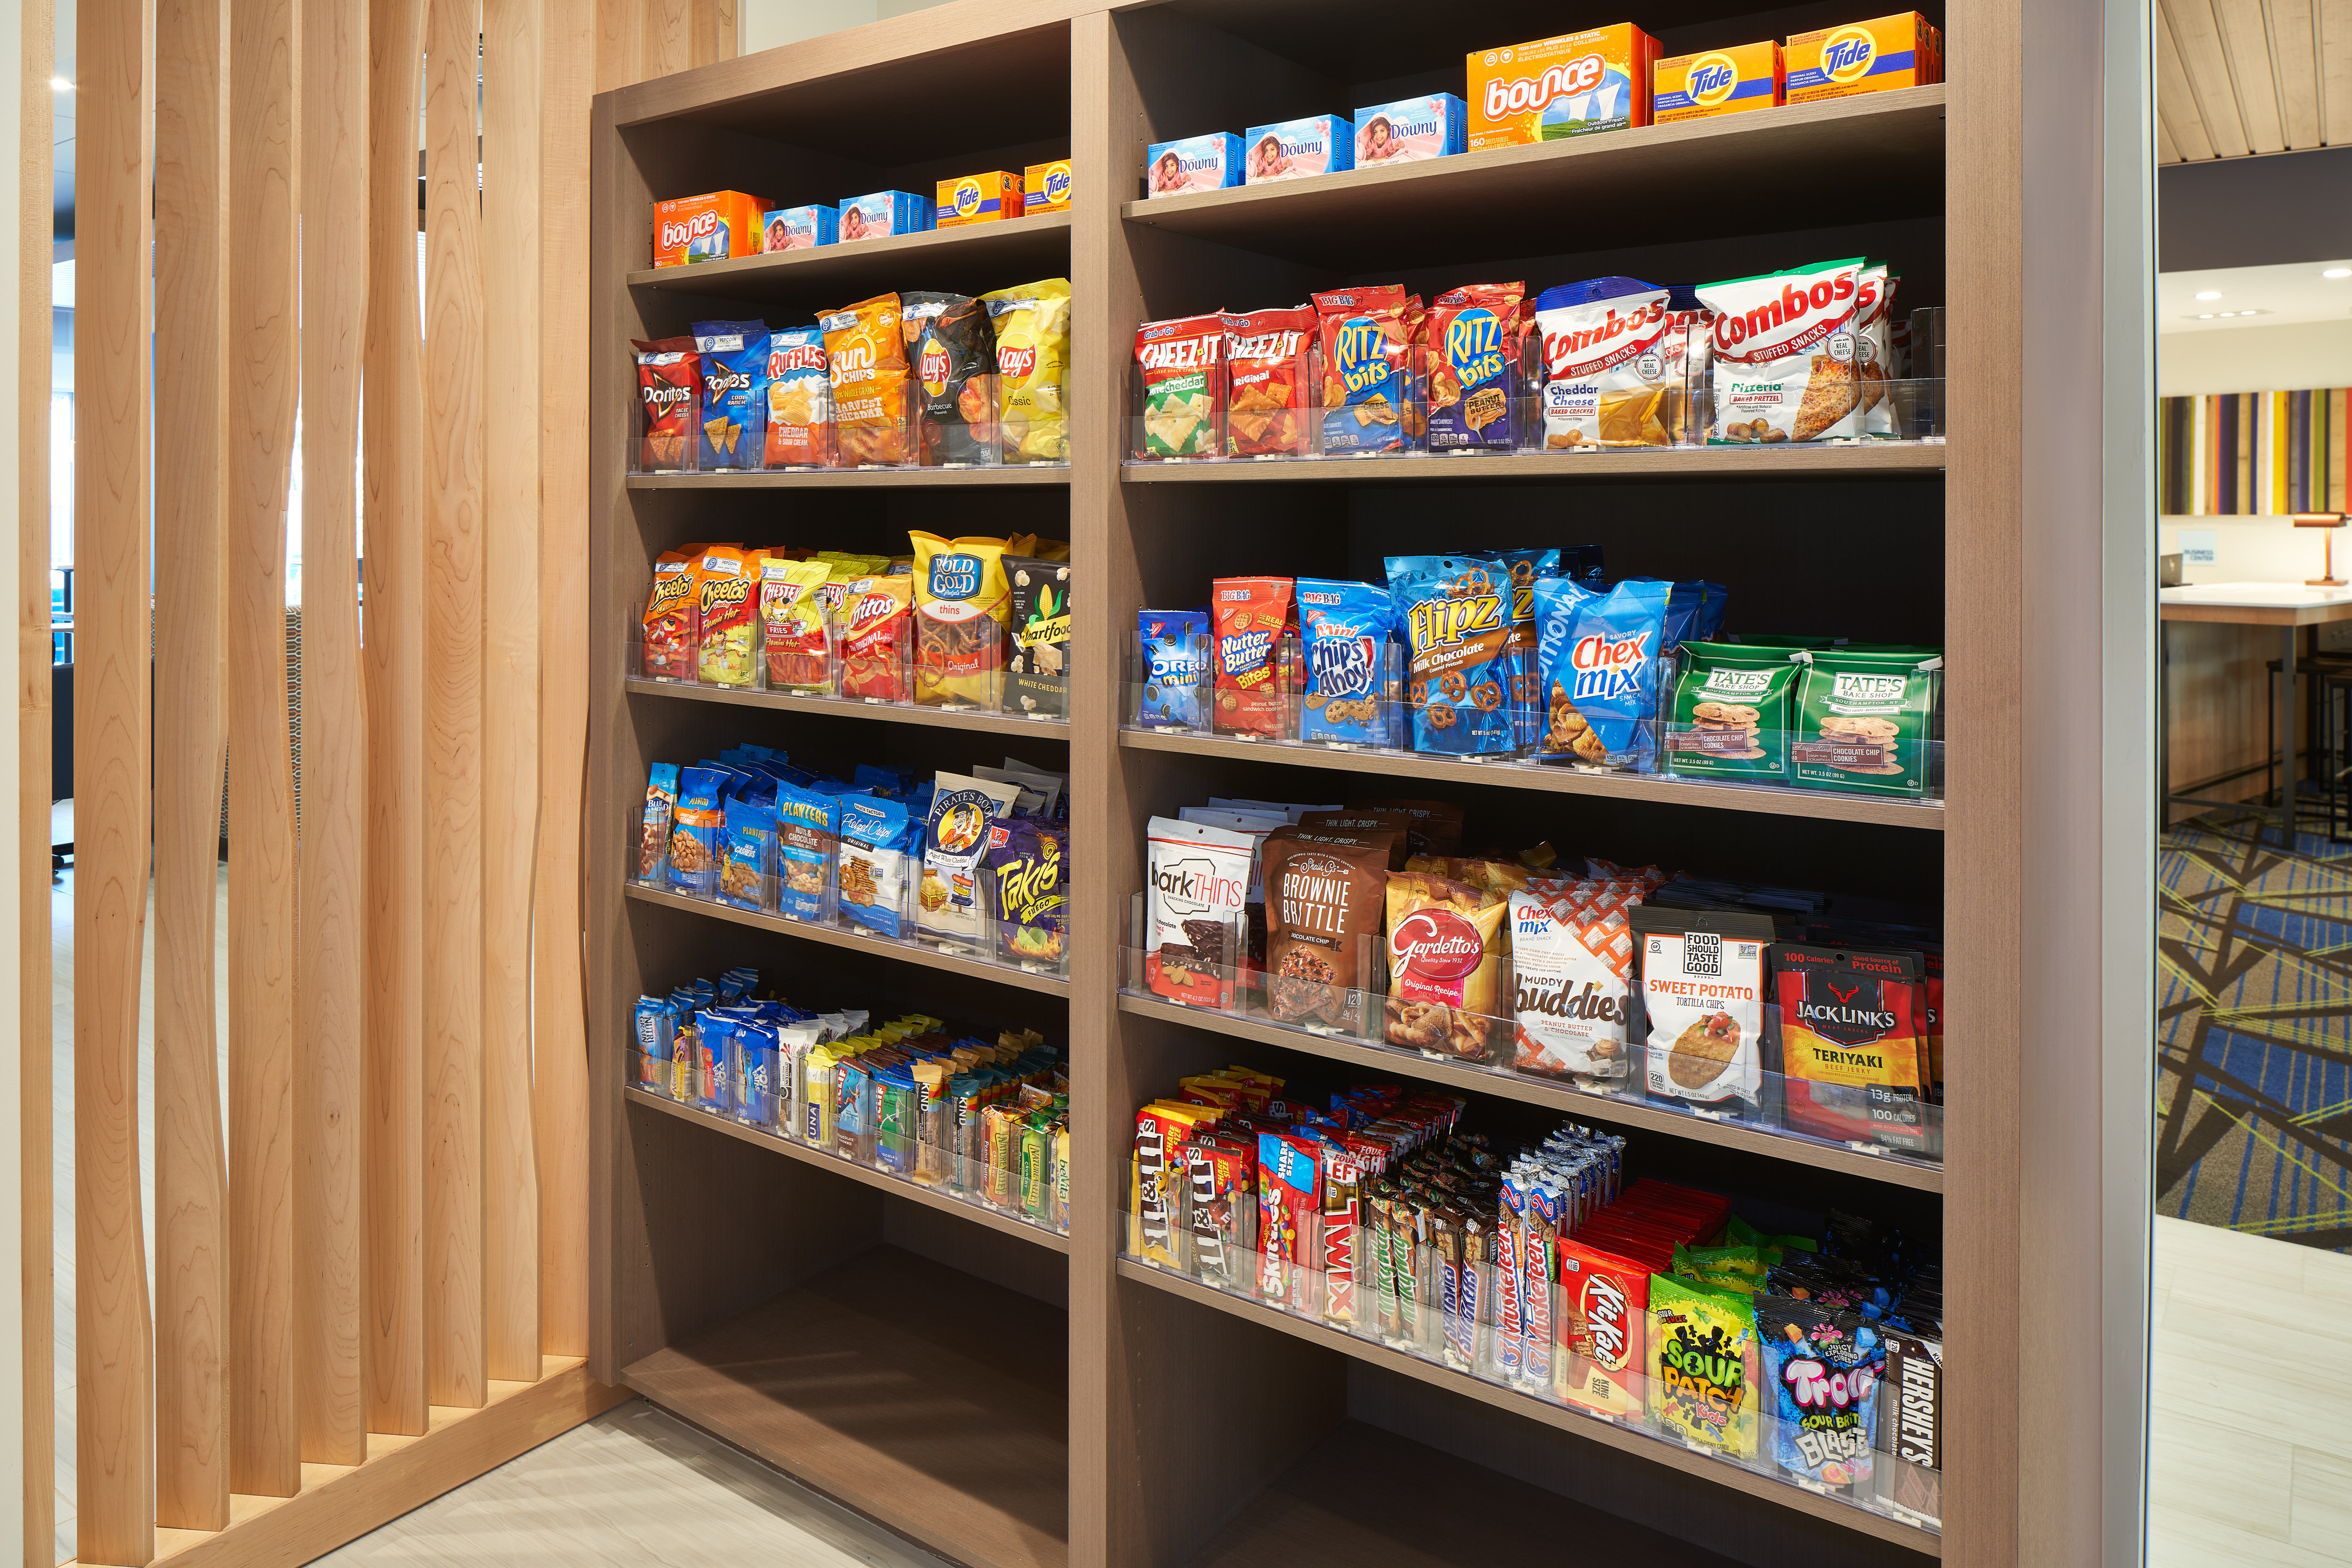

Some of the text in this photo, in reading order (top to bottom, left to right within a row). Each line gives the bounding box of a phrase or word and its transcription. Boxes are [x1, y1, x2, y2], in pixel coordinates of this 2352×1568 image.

[1543, 36, 1574, 47] WRINKLES
[1580, 32, 1600, 40] STATIC
[1518, 48, 1571, 62] ÉLECTROSTATIQUE
[1825, 38, 1871, 77] Tide
[1486, 56, 1600, 116] bounce
[1690, 64, 1733, 101] Tide
[1390, 120, 1437, 139] Downy
[1279, 141, 1322, 158] Downy
[1470, 137, 1485, 147] 160
[1179, 157, 1218, 173] Downy
[1046, 172, 1070, 199] Tide
[956, 187, 979, 212] Tide
[860, 212, 888, 224] Downy
[663, 212, 717, 247] bounce
[785, 225, 811, 237] Downy
[1319, 295, 1354, 306] BIG BAG
[1715, 271, 1855, 350] Combos
[1144, 329, 1158, 339] Grab
[1543, 297, 1664, 362] Combos
[1335, 326, 1385, 371] RITZ
[1446, 316, 1500, 366] RITZ
[1753, 324, 1827, 361] STUFFED SNACKS
[767, 345, 826, 380] RUFFLES
[922, 354, 946, 384] Lay's
[999, 346, 1033, 378] Lay's
[1570, 344, 1637, 376] STUFFED SNACKS
[842, 368, 875, 384] CHIPS
[1345, 360, 1389, 392] bits
[1457, 353, 1503, 388] bits
[844, 386, 874, 398] WHOLE GRAIN
[1165, 376, 1204, 393] cheddar
[1550, 384, 1598, 395] Cheddar
[644, 387, 691, 404] Doritos
[1469, 393, 1500, 409] PEANUT
[1470, 401, 1501, 414] BUTTER
[779, 426, 808, 438] CHEDDAR
[936, 557, 974, 574] ROLD
[934, 574, 974, 594] GOLD
[700, 579, 748, 614] Cheetos
[1303, 593, 1341, 605] BIG BAG
[850, 597, 894, 630] Fritos
[939, 605, 960, 615] thins
[1316, 624, 1359, 638] Mini
[1410, 596, 1500, 657] Flipz
[1609, 630, 1637, 640] SAVORY
[1222, 632, 1269, 656] Nutter
[1573, 631, 1649, 669] Chex
[948, 659, 979, 674] Original
[1224, 645, 1271, 673] Butter
[1312, 638, 1362, 677] Chips
[1414, 642, 1484, 674] Milk Chocolate
[1152, 660, 1207, 676] OREO
[1018, 678, 1067, 694] WHITE CHEDDAR
[1163, 672, 1197, 685] mini
[1236, 667, 1271, 689] Bites
[1579, 661, 1641, 697] mix
[1839, 677, 1902, 692] TATE'S
[782, 802, 828, 827] PLANTERS
[855, 804, 866, 813] SNACK
[788, 833, 818, 846] CHOCOLATE
[795, 827, 806, 836] NUTS
[847, 838, 869, 849] ORIGINAL
[1283, 873, 1351, 907] BROWNIE
[1028, 899, 1050, 916] FUEGO
[1283, 899, 1349, 934] BRITTLE
[1517, 905, 1553, 920] Chex
[1519, 919, 1551, 935] mix
[1391, 915, 1479, 979] Gardetto's
[1687, 934, 1719, 946] FOOD
[1687, 945, 1719, 954] SHOULD
[1686, 962, 1718, 973] GOOD
[1687, 953, 1718, 963] TASTE
[1784, 953, 1805, 963] 100
[1851, 961, 1902, 974] Protein
[1405, 979, 1458, 997] Original Recipe
[1525, 976, 1563, 987] MUDDY
[1649, 979, 1753, 1000] SWEET POTATO
[1516, 972, 1629, 1026] buddies
[1676, 997, 1724, 1010] TORTILLA CHIPS
[1796, 1000, 1895, 1027] JACK LINK'S
[1812, 1048, 1883, 1068] TERIYAKI
[1847, 1066, 1871, 1075] JERKY
[921, 1082, 930, 1112] KIND
[1278, 1140, 1288, 1179] SHARE
[1286, 1150, 1295, 1178] SIZE
[1324, 1198, 1359, 1317] TWIX
[1668, 1340, 1744, 1387] SOUR
[1825, 1350, 1858, 1361] EXPLODING
[1592, 1377, 1600, 1396] SIZE
[1663, 1366, 1745, 1411] PATCH
[1695, 1402, 1727, 1426] Kids
[1901, 1356, 1934, 1467] HERSHEY'S
